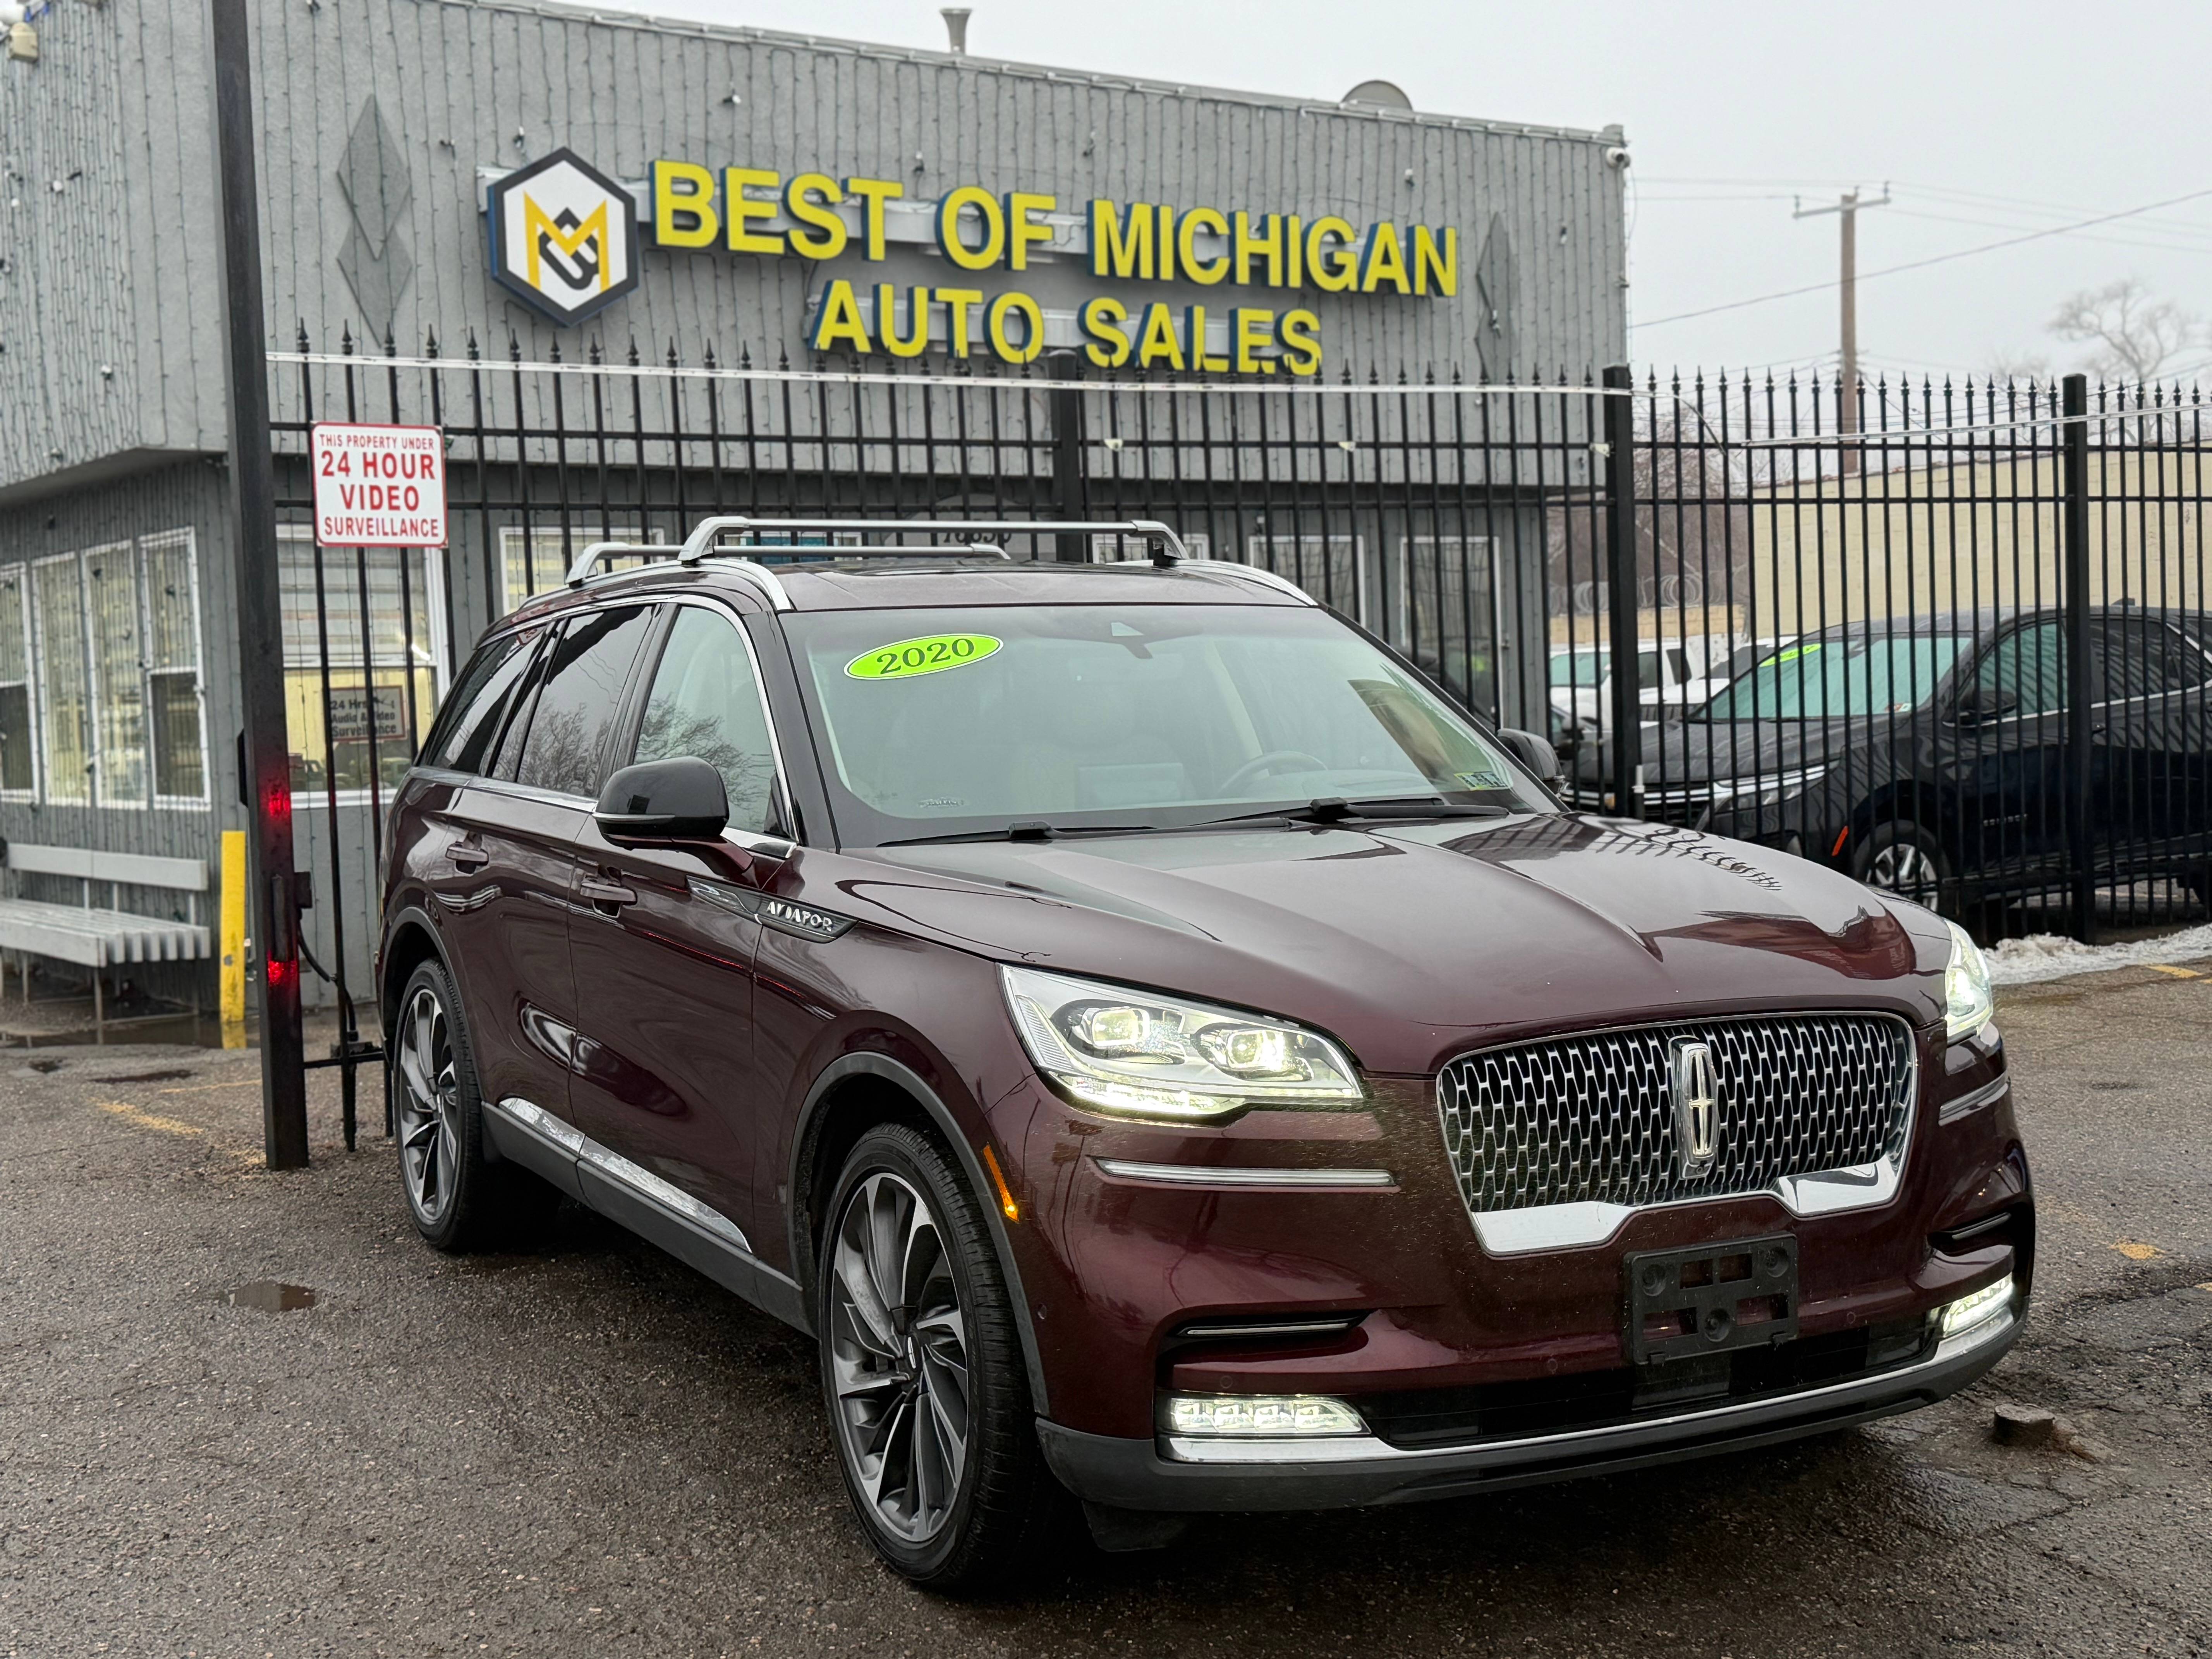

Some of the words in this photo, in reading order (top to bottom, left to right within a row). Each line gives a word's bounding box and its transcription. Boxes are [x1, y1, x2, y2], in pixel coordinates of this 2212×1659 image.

[654, 161, 903, 260] BEST
[939, 186, 1056, 270] OF
[1091, 199, 1457, 296] MICHIGAN
[814, 280, 1044, 364] AUTO
[1083, 298, 1322, 376] SALES
[320, 434, 342, 447] THIS
[347, 435, 397, 448] PROPERTY
[402, 437, 434, 450] UNDER
[321, 450, 351, 477] 24
[362, 452, 435, 480] HOUR
[340, 484, 419, 512] VIDEO
[325, 516, 438, 537] SURVEILLANCE
[876, 638, 974, 675] 2020
[331, 700, 345, 710] 24
[332, 713, 357, 723] Audio
[766, 901, 833, 932] AVIATOR
